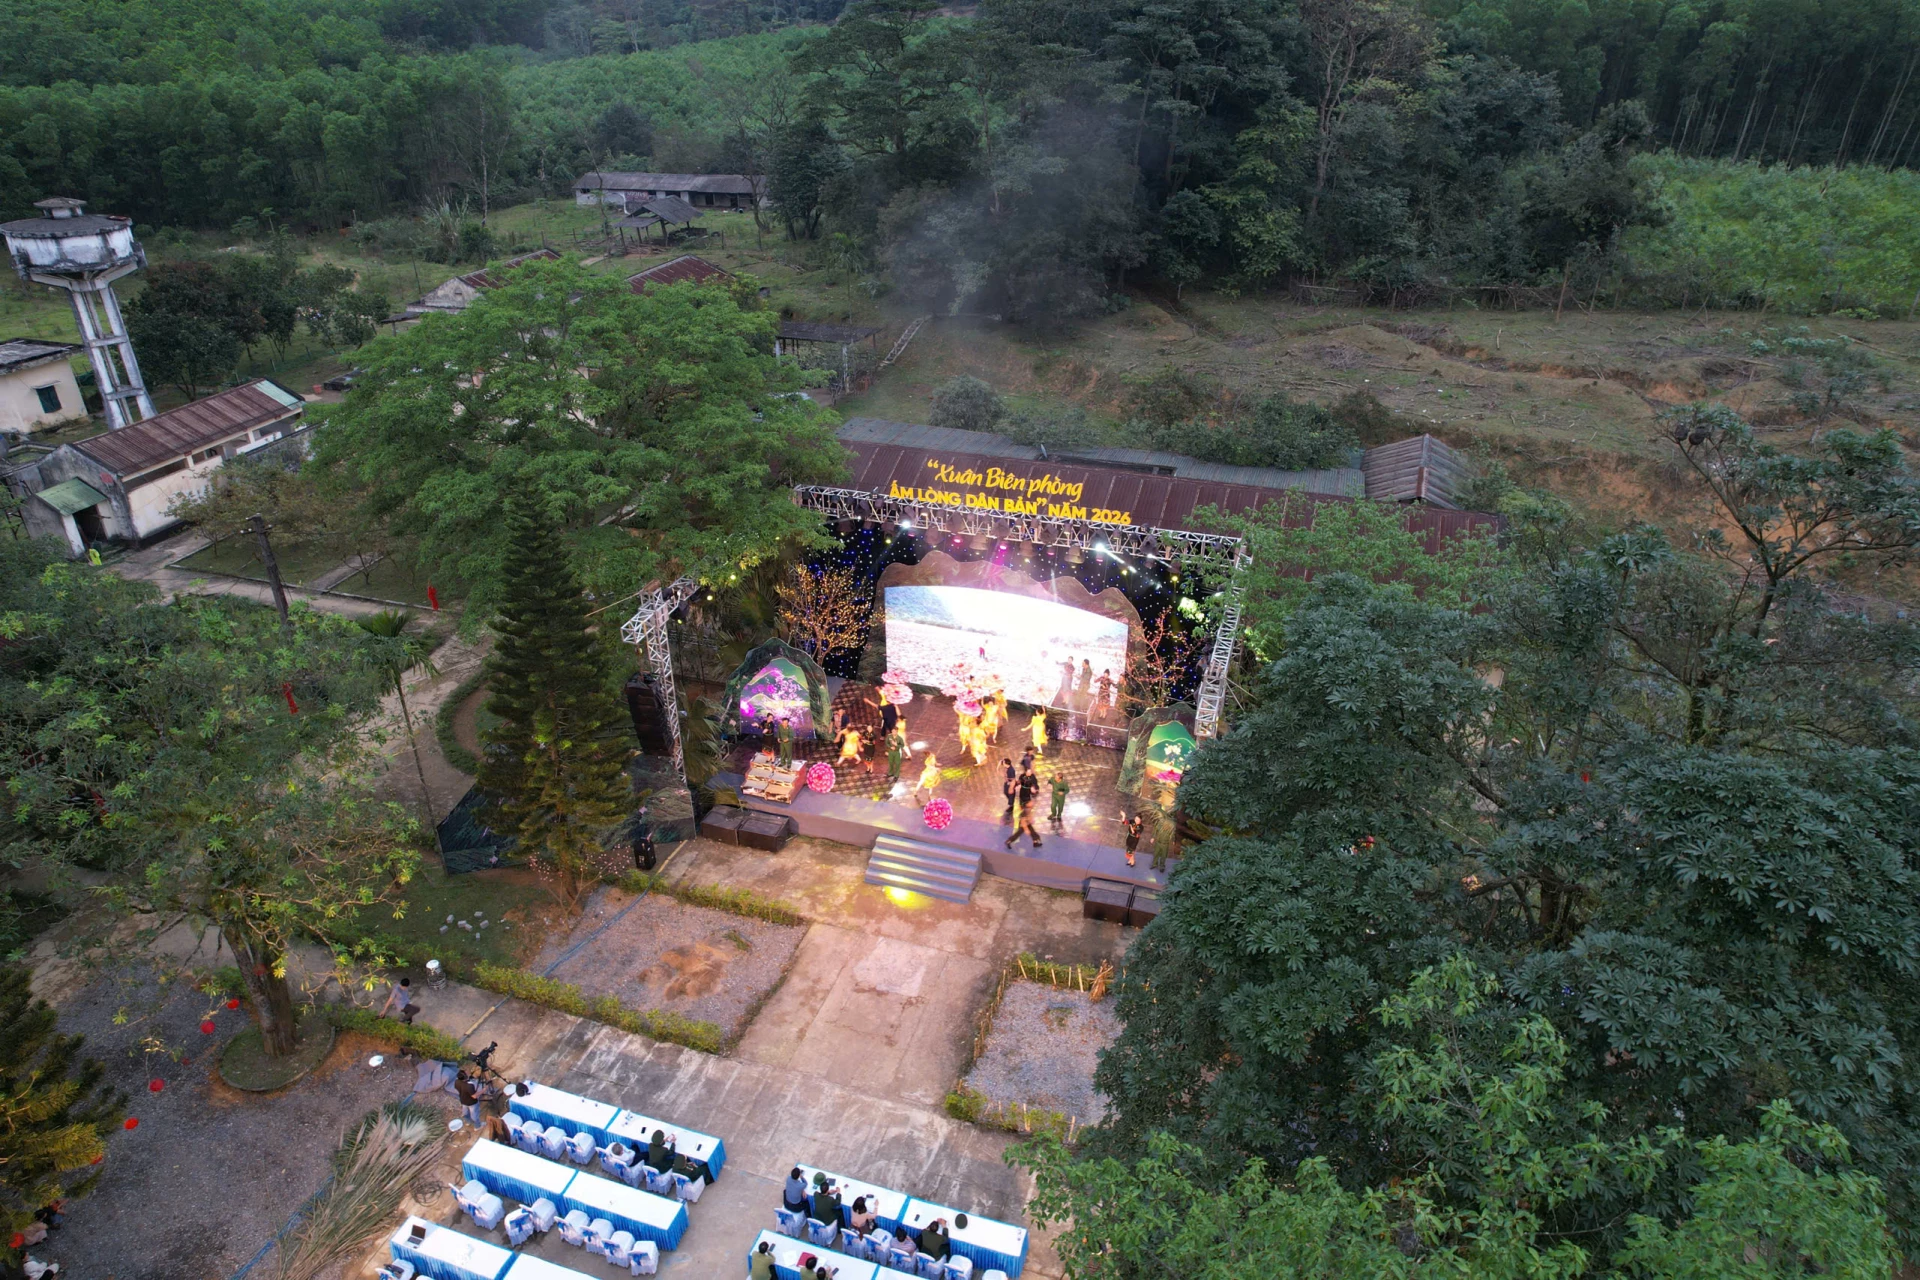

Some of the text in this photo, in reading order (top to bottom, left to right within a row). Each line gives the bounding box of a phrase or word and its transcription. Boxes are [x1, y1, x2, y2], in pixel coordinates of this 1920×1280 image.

[889, 479, 914, 500] ẤM
[917, 485, 962, 507] LÒNG
[965, 492, 1000, 511] DÂN
[1048, 501, 1087, 521] NĂM
[1090, 507, 1132, 526] 2026
[985, 467, 1026, 491] Biên
[1026, 473, 1084, 503] phòng
